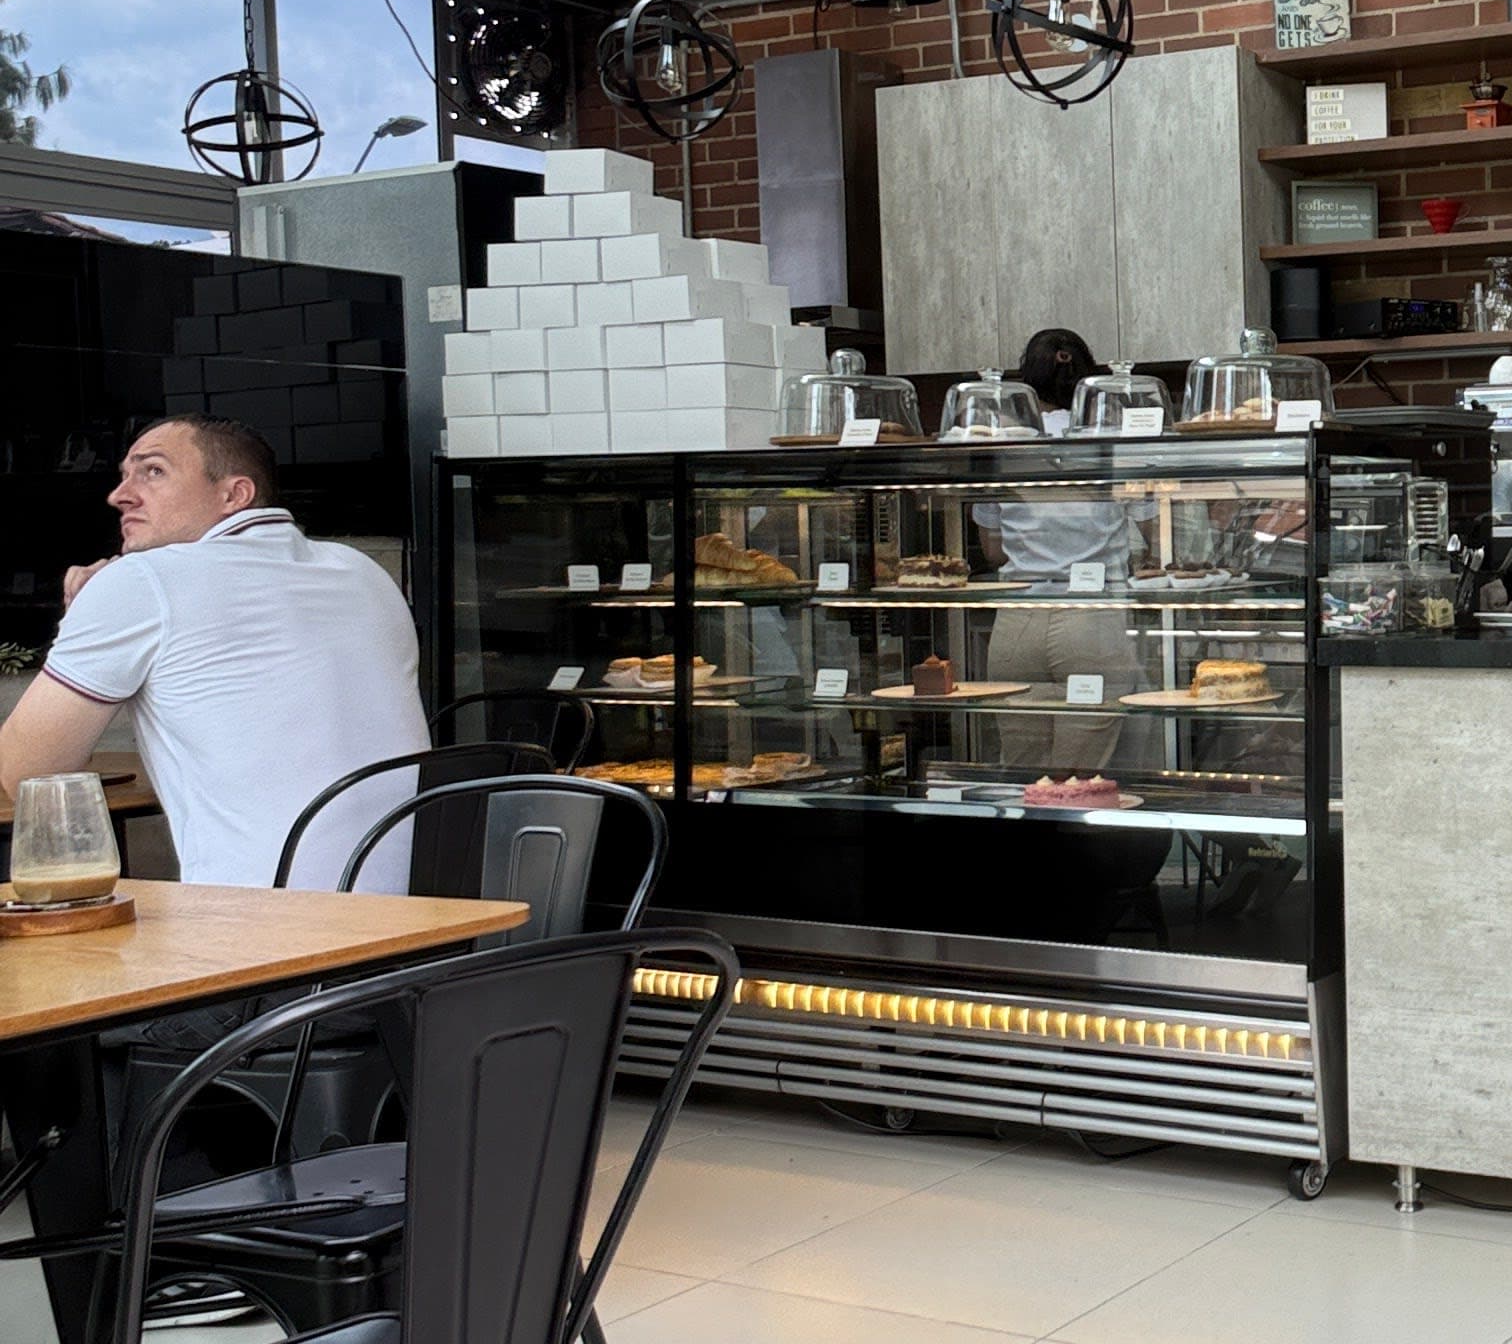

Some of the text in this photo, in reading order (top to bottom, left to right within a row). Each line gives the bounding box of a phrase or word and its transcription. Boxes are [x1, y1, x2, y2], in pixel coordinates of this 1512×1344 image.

[1278, 14, 1312, 31] NO ONE
[1279, 31, 1312, 48] GETS
